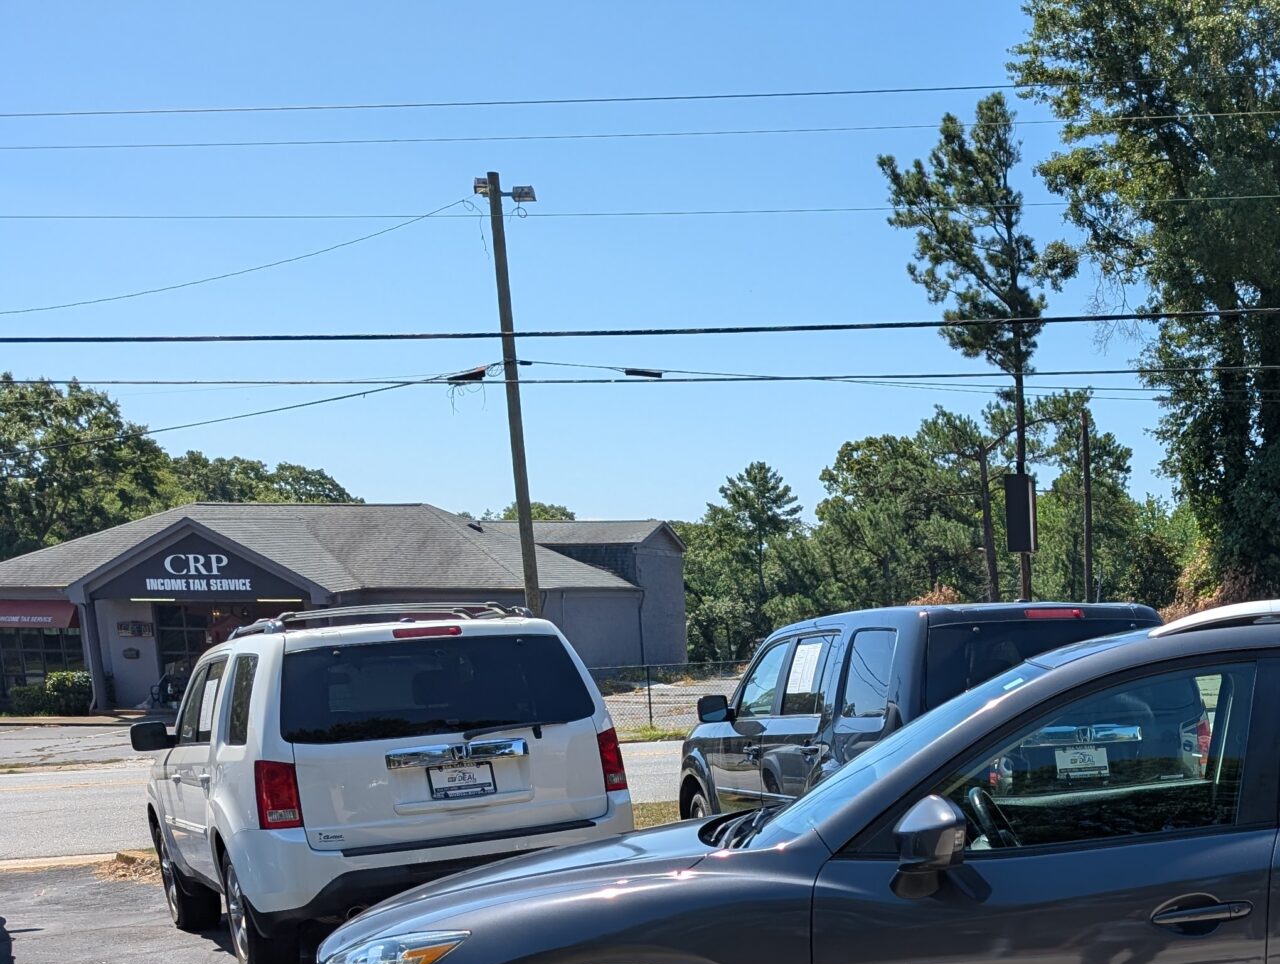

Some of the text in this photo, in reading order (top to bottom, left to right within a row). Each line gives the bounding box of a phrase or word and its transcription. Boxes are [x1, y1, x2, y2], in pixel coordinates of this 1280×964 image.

[164, 554, 228, 575] CRP
[146, 578, 252, 591] INCOME TAX SERVICE
